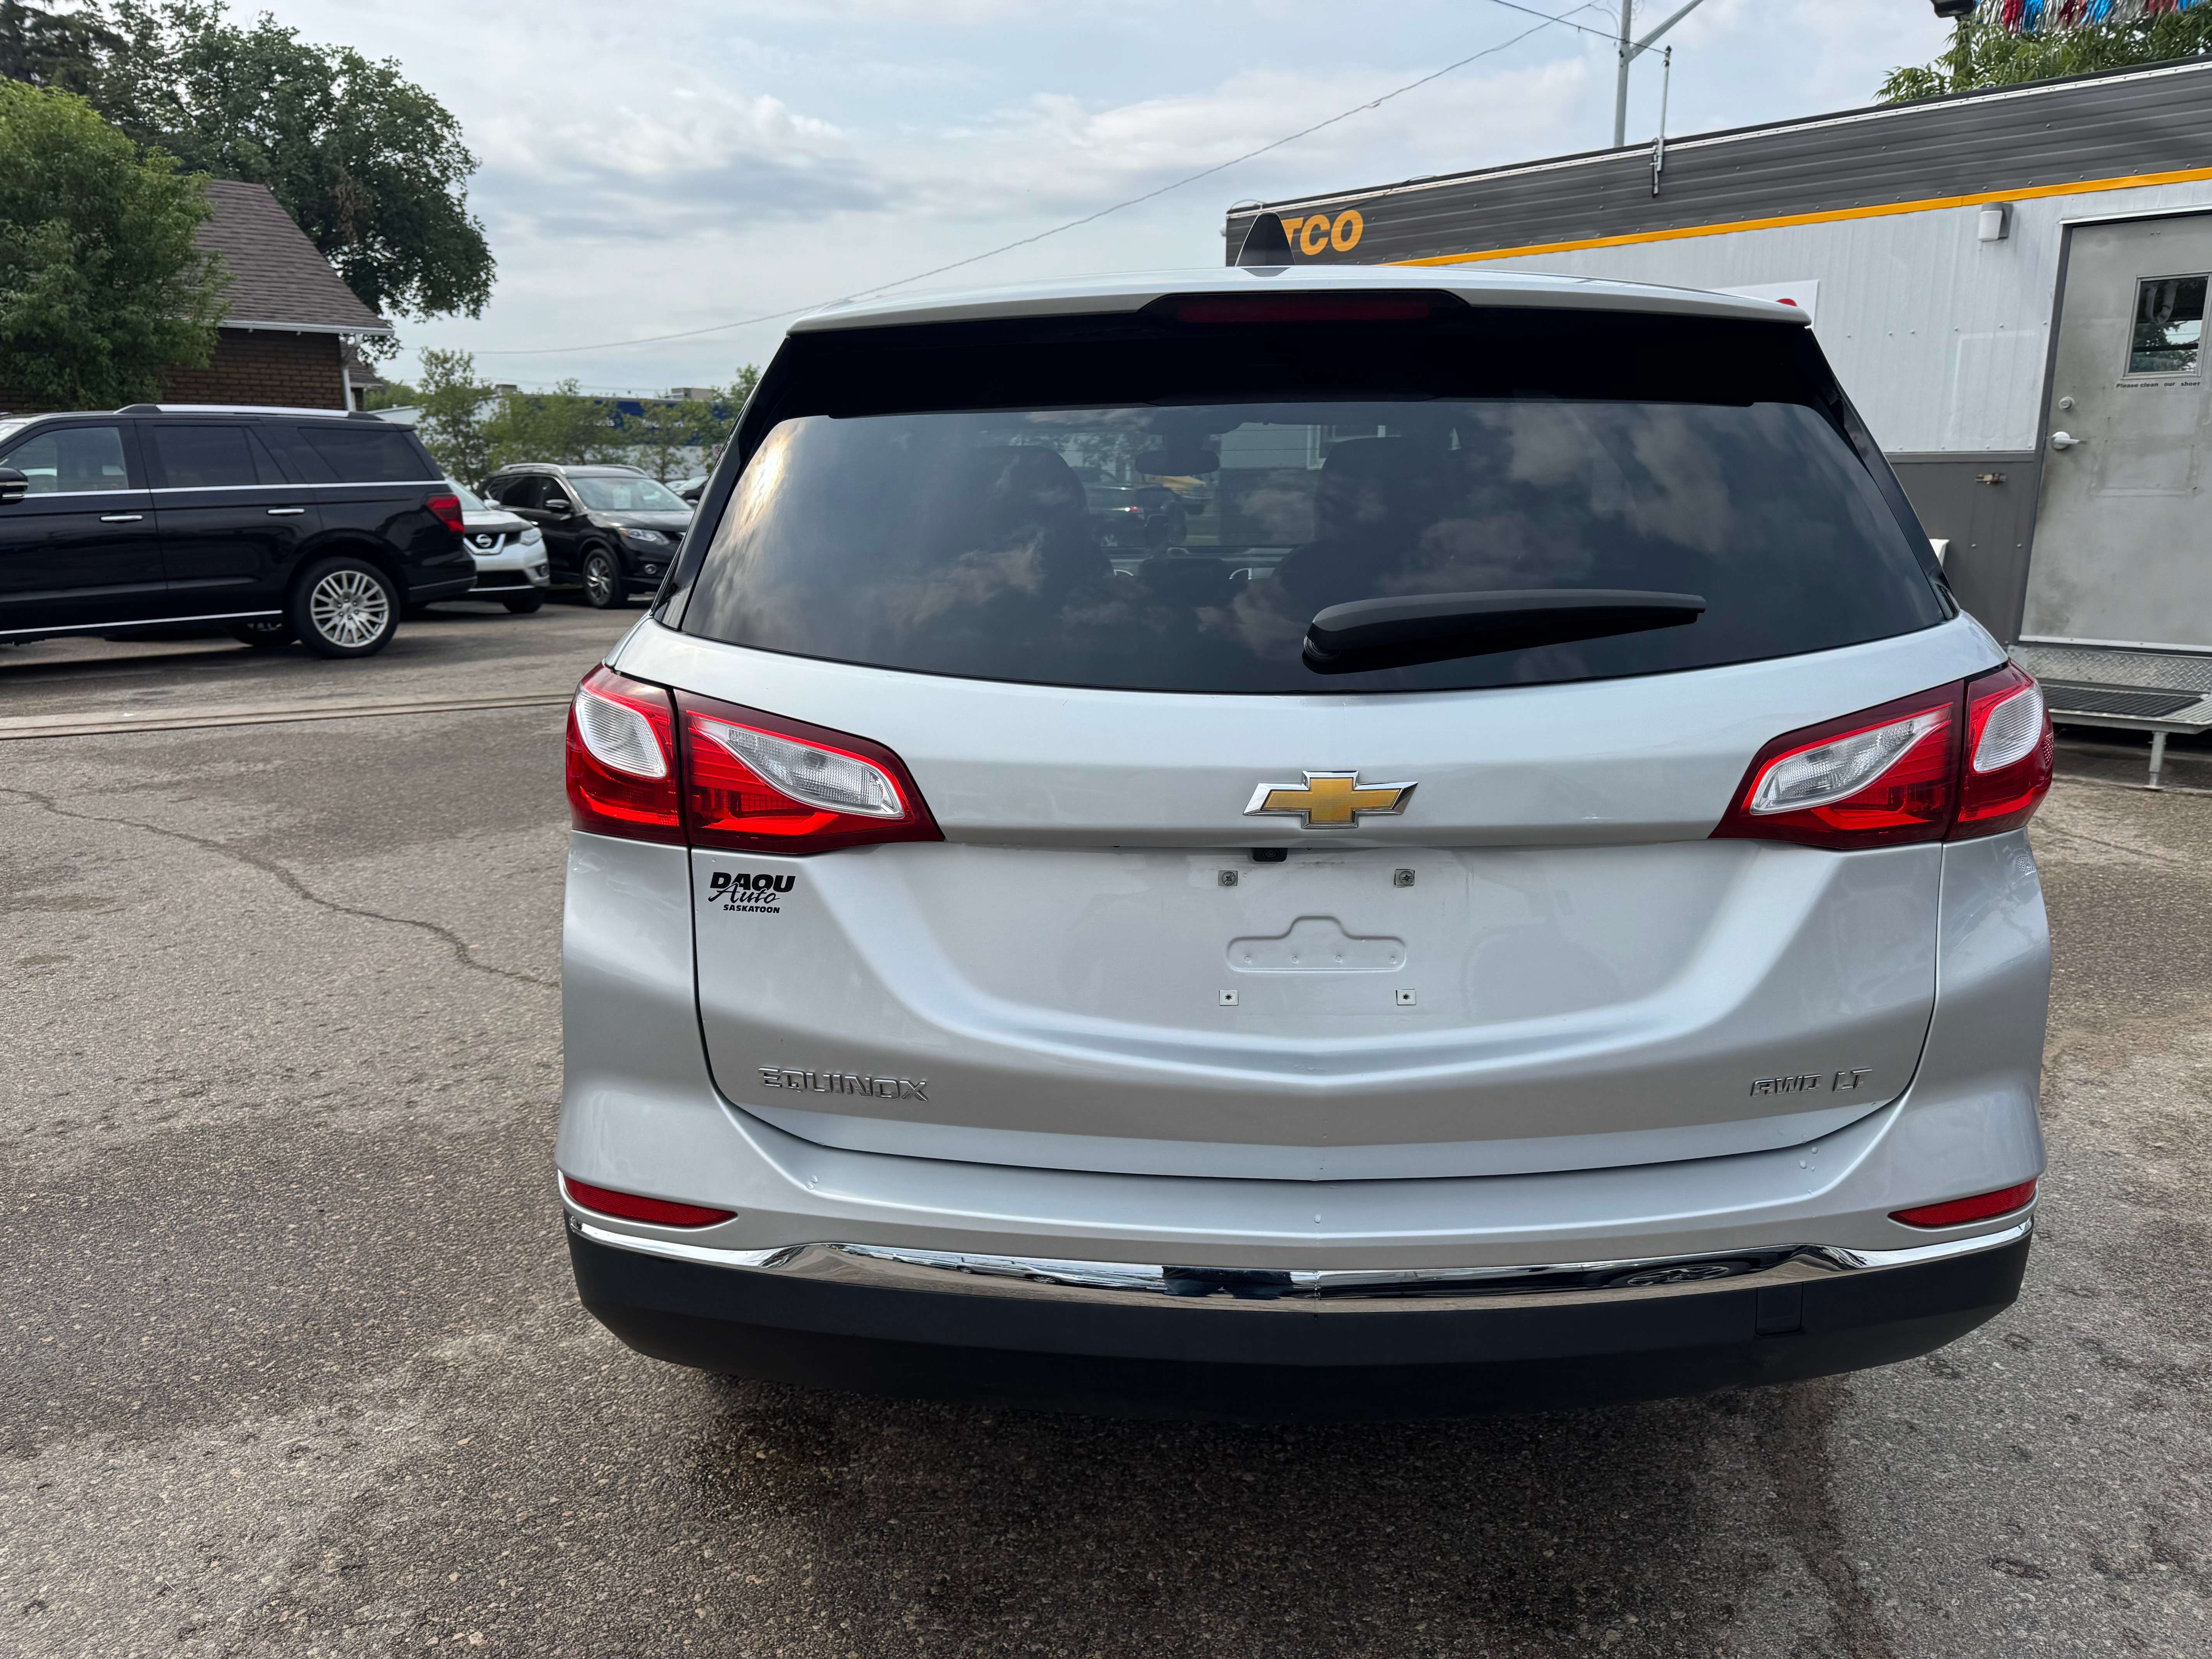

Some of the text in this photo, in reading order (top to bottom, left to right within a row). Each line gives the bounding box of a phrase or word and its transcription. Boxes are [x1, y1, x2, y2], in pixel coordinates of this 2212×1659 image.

[1281, 210, 1364, 256] TCO
[708, 883, 780, 904] Auto
[710, 872, 796, 893] DAOU
[723, 904, 780, 913] SASKATOON
[758, 1067, 928, 1101] EQUINOX
[1750, 1068, 1873, 1097] AWD LT
